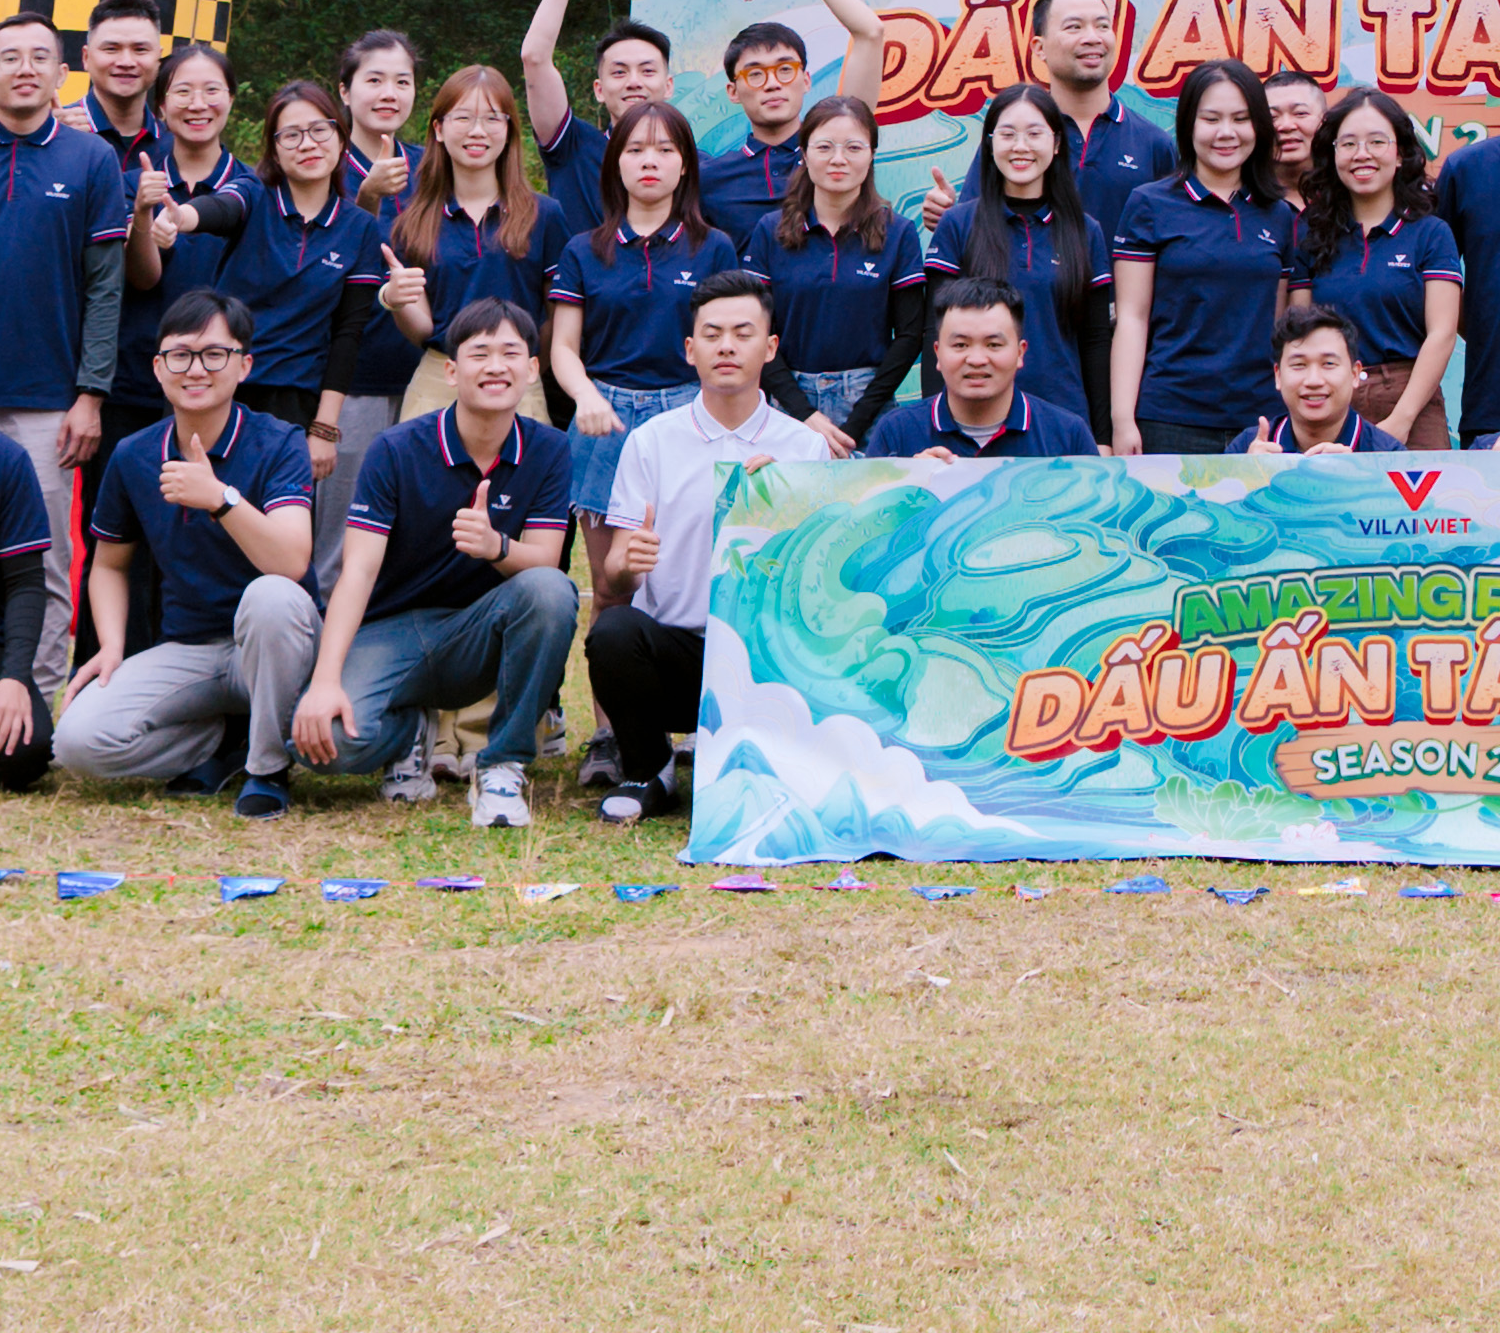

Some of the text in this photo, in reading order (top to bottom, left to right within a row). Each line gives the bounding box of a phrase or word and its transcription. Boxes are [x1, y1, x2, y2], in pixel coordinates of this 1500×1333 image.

[1359, 517, 1472, 535] VILAI VIET
[1182, 575, 1464, 639] AMAZING
[1007, 622, 1230, 754] DẤU
[1237, 608, 1395, 722] ẤN
[1312, 739, 1480, 783] SEASON
